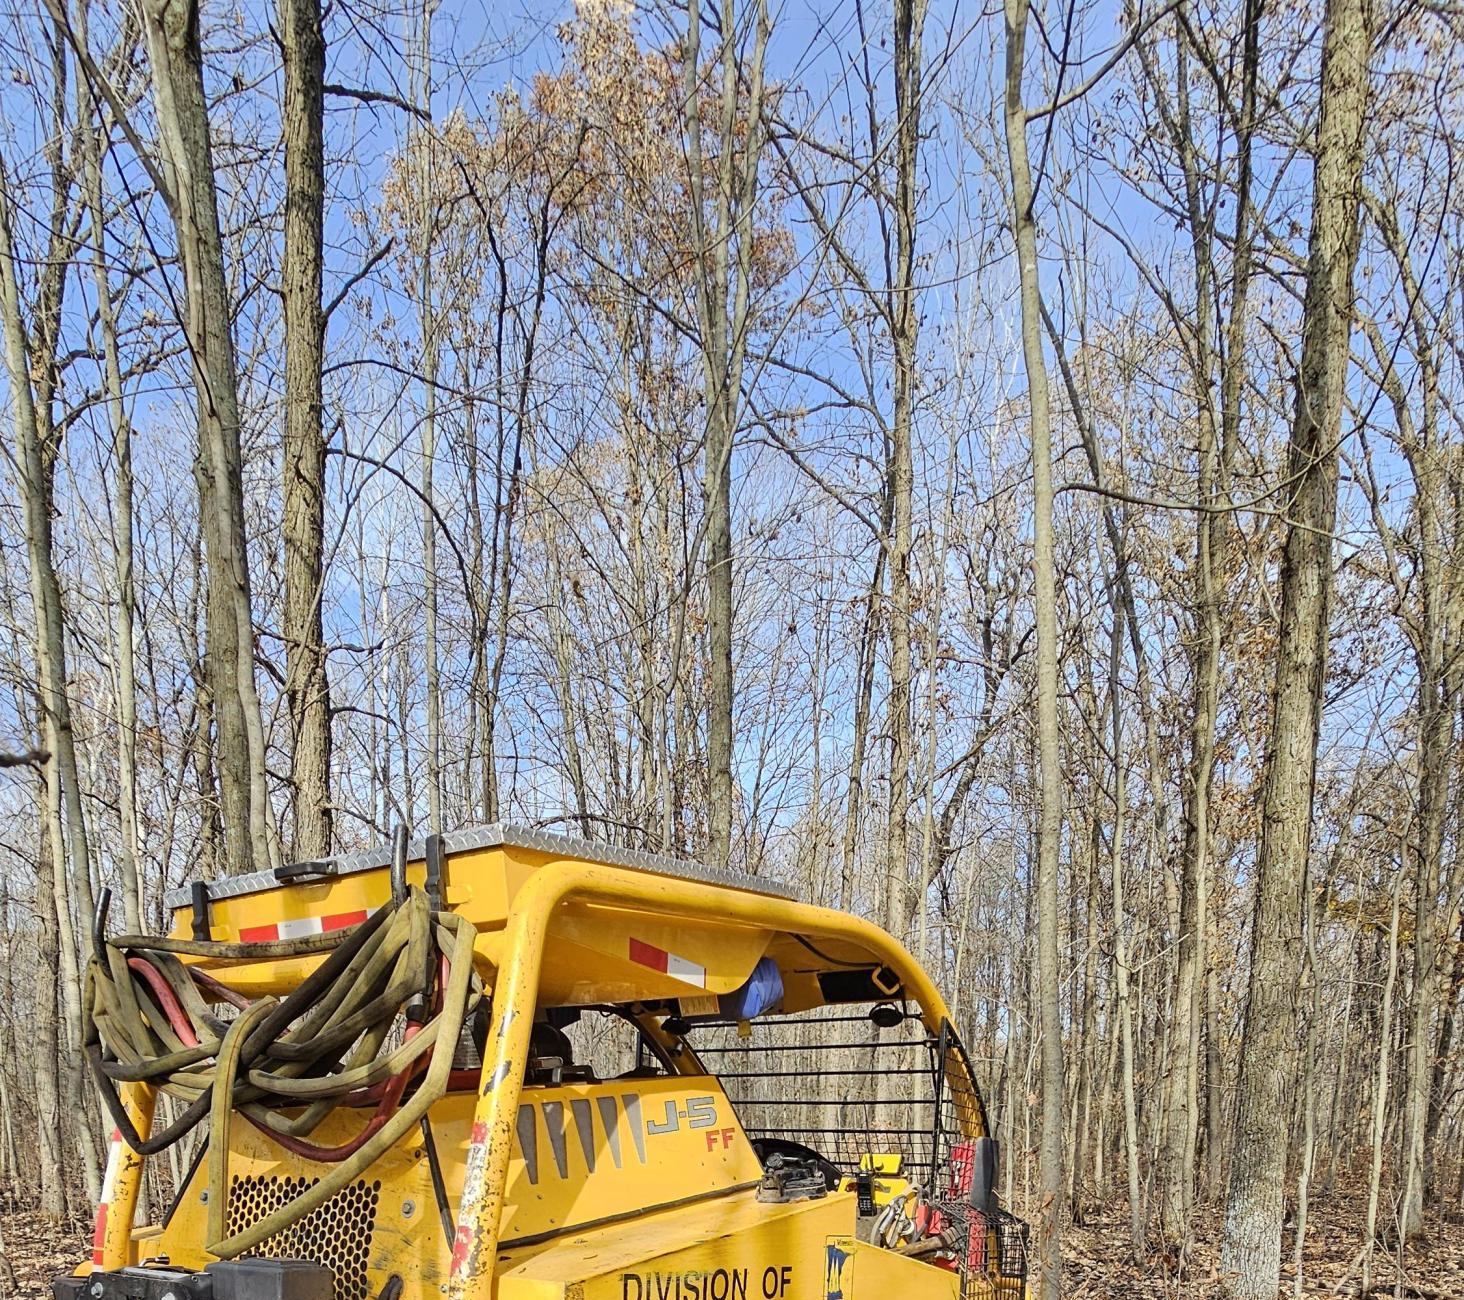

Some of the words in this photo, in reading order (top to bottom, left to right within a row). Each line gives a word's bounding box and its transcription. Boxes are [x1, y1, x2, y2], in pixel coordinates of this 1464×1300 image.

[647, 1096, 718, 1135] J-5
[705, 1127, 735, 1153] FF
[762, 1266, 793, 1299] OF
